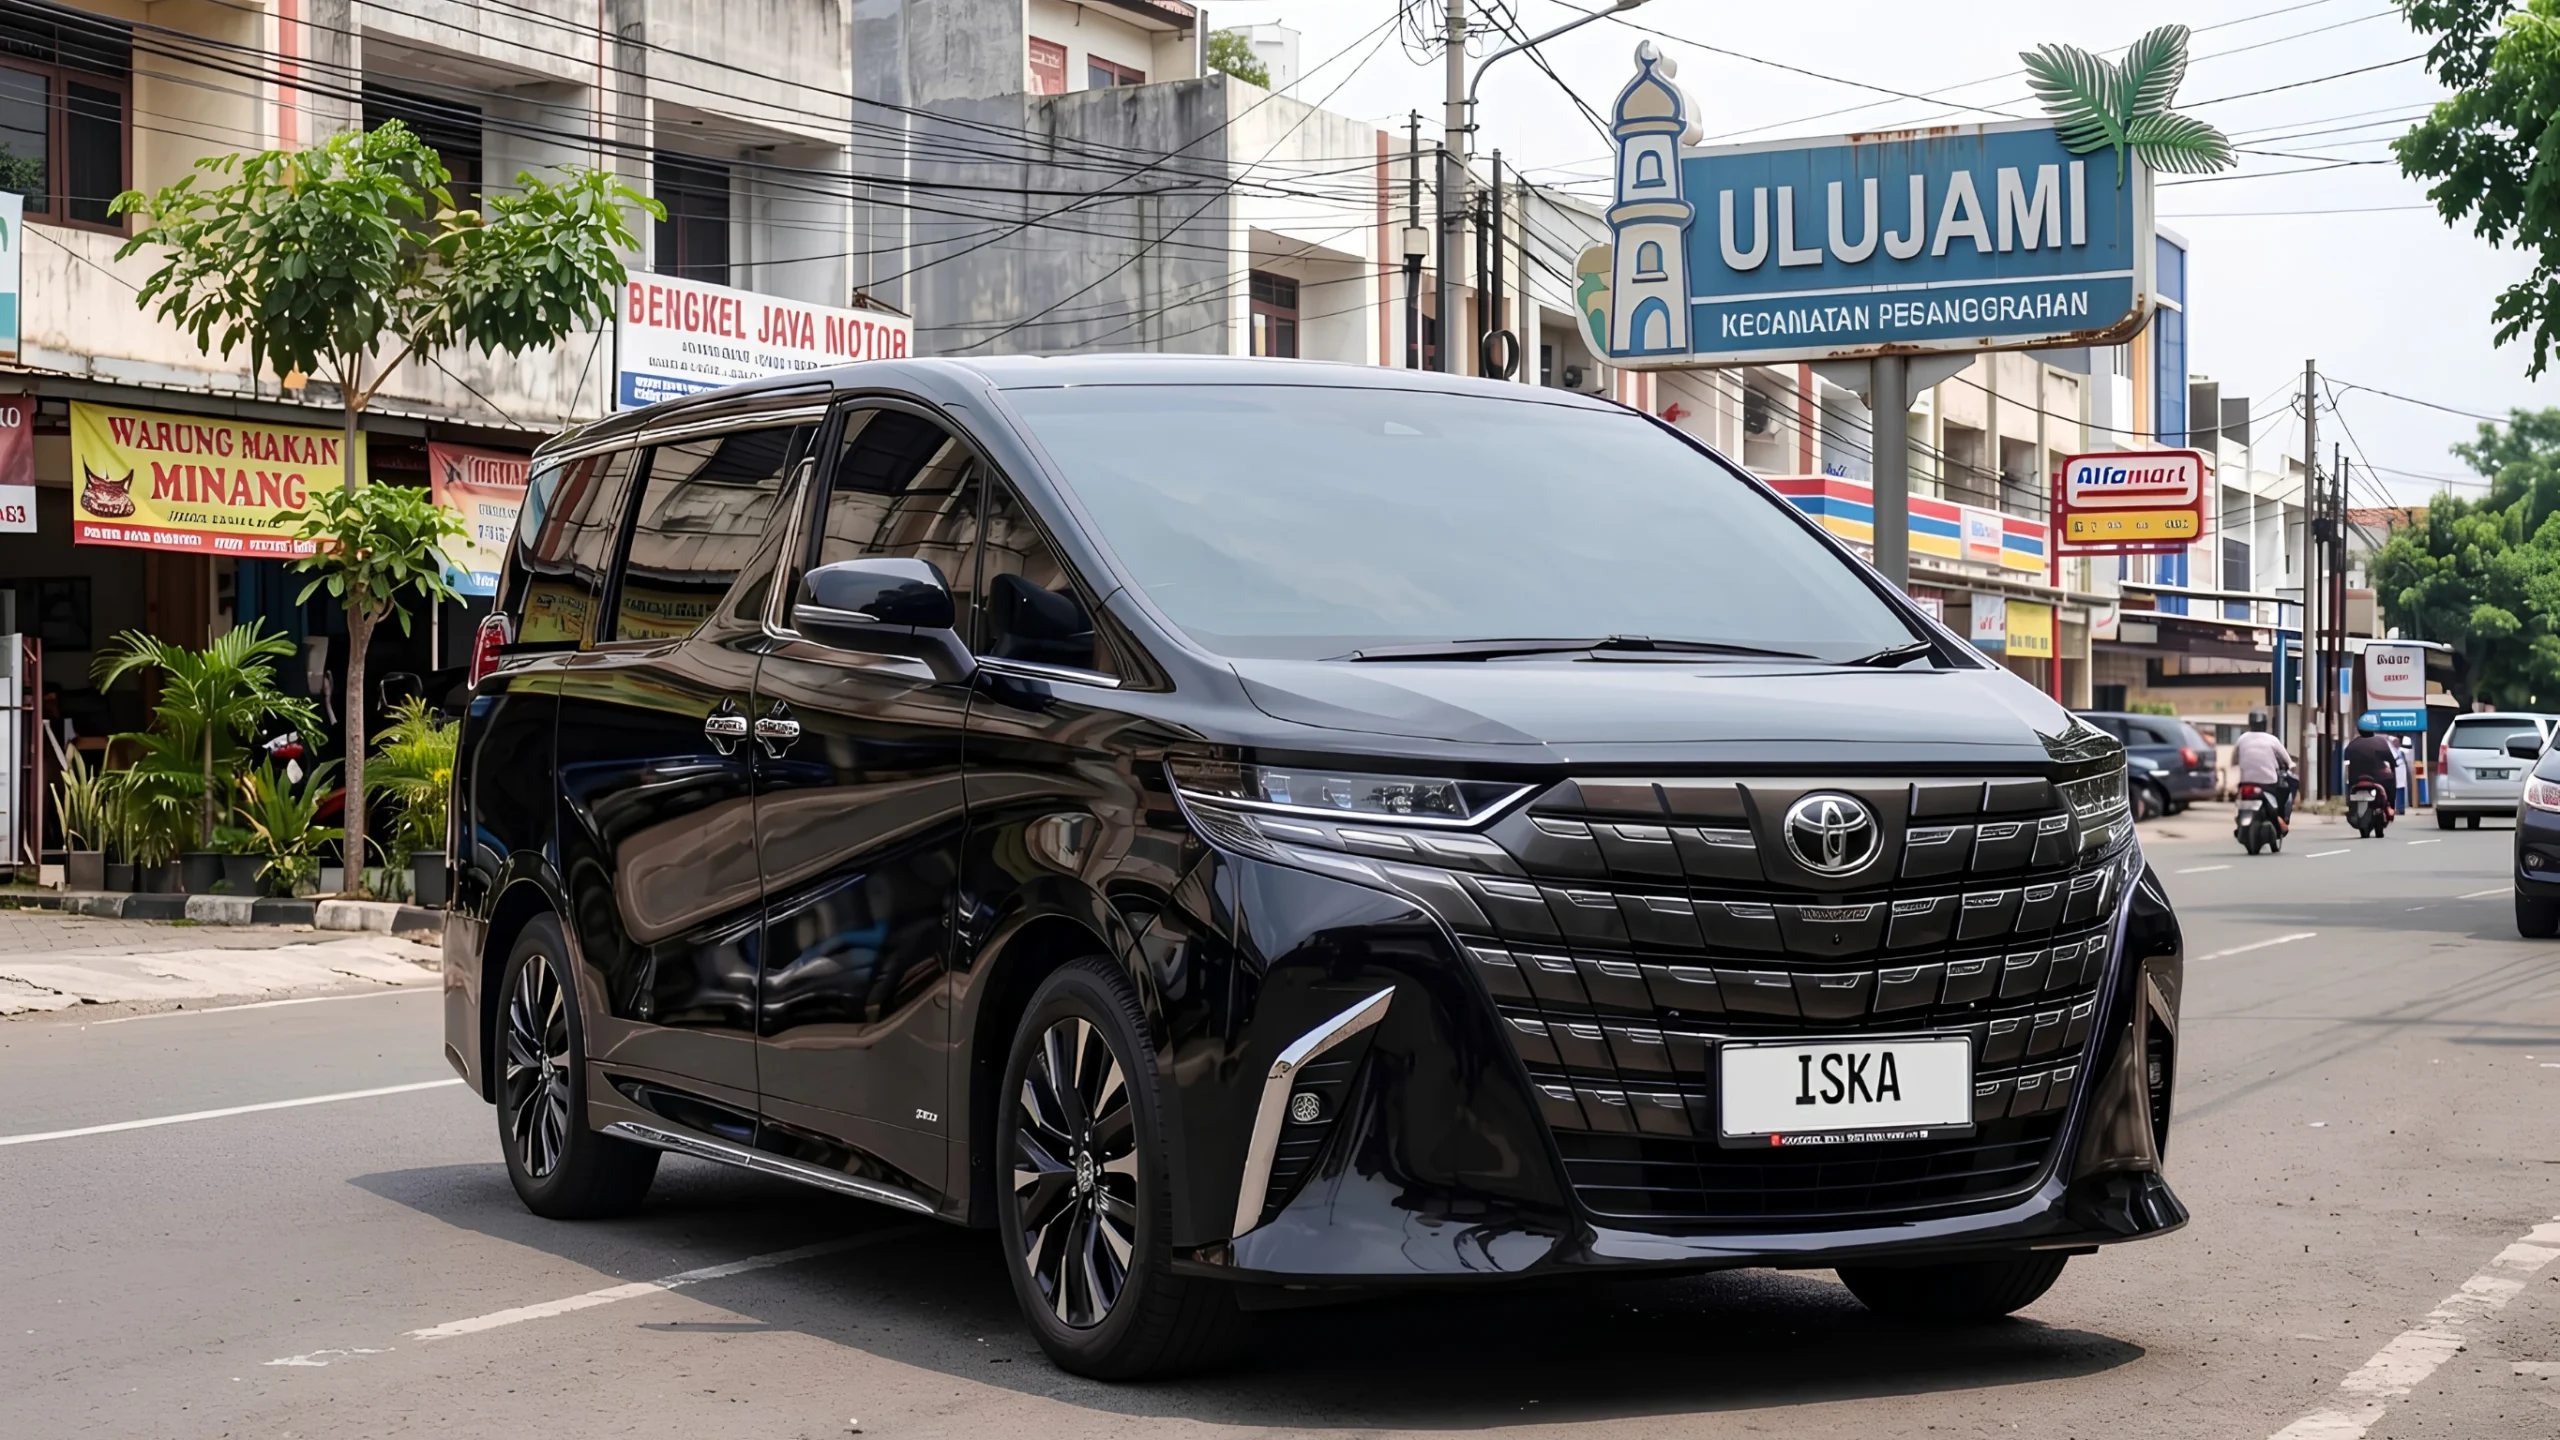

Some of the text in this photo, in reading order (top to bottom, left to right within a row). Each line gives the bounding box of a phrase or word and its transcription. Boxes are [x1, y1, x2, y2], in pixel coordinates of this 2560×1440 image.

[1719, 160, 2087, 271] ULUJAMI
[628, 282, 746, 340] BENGKEL
[758, 305, 815, 351] JAYA
[108, 416, 339, 465] WARUNG MAKAN
[150, 461, 306, 510] MINANG
[1795, 1052, 1901, 1105] ISKA
